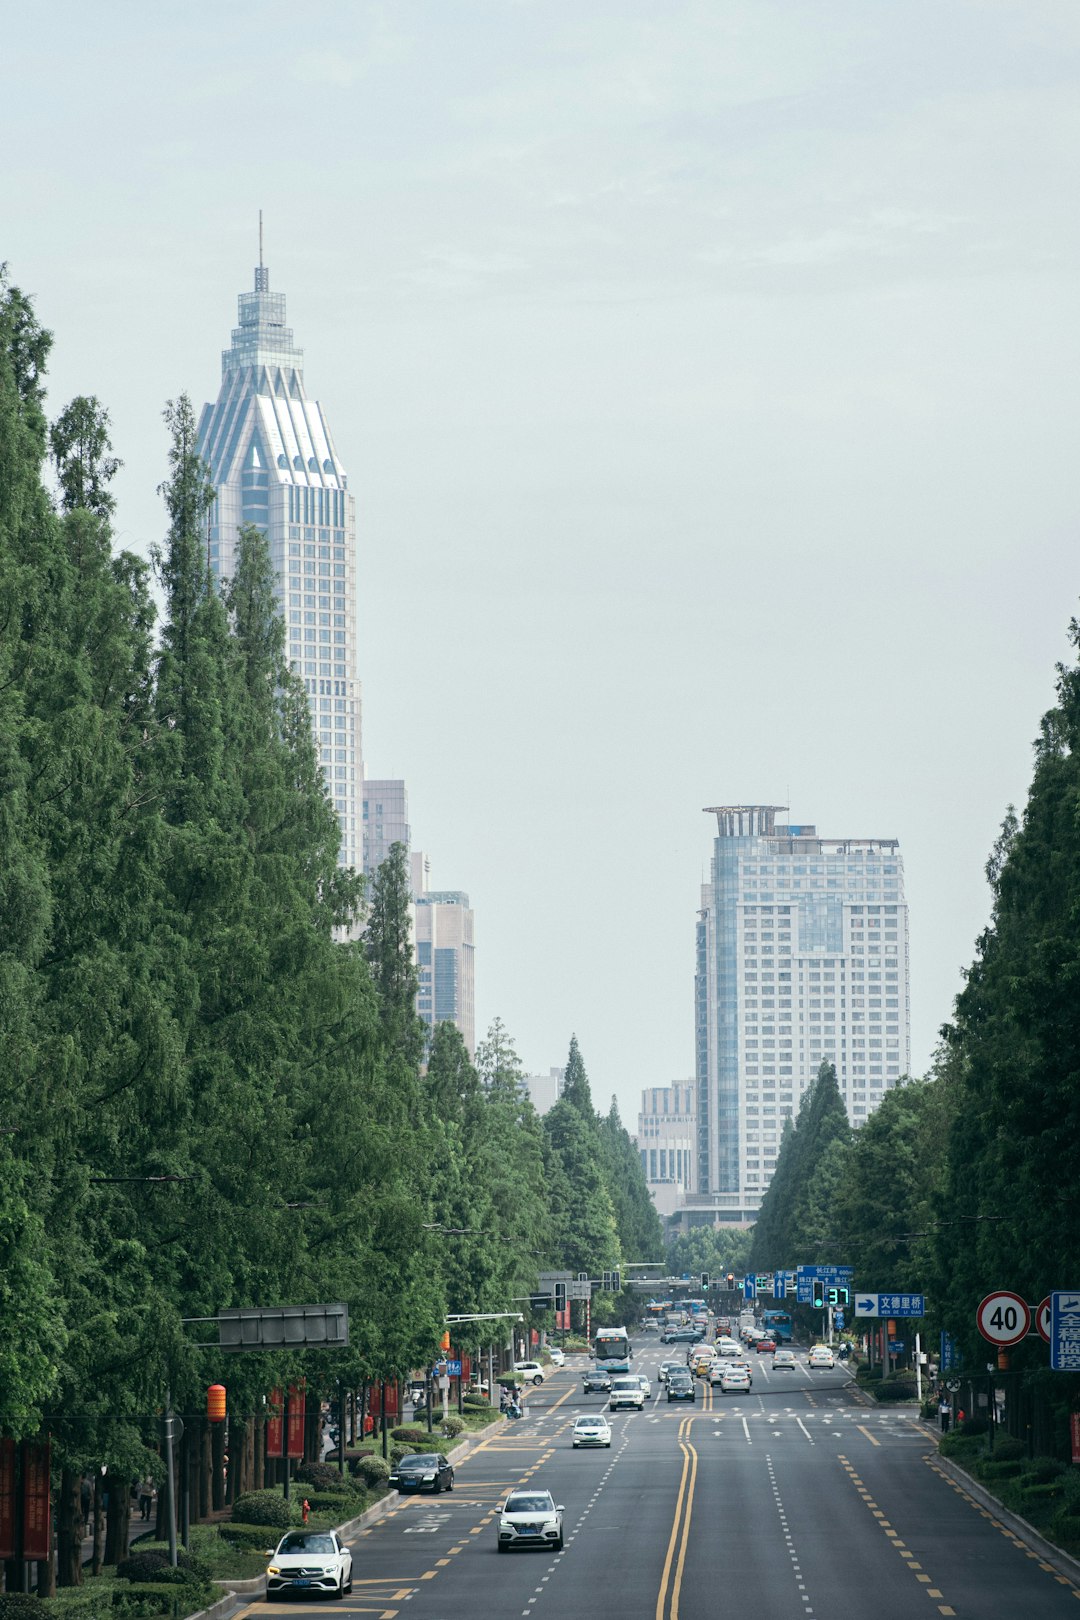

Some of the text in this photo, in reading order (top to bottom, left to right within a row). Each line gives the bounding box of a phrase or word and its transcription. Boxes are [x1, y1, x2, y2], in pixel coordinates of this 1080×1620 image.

[829, 1288, 848, 1304] 37
[881, 1296, 921, 1309] 文德里桥
[990, 1306, 1017, 1331] 40
[1057, 1313, 1080, 1369] 全程监控
